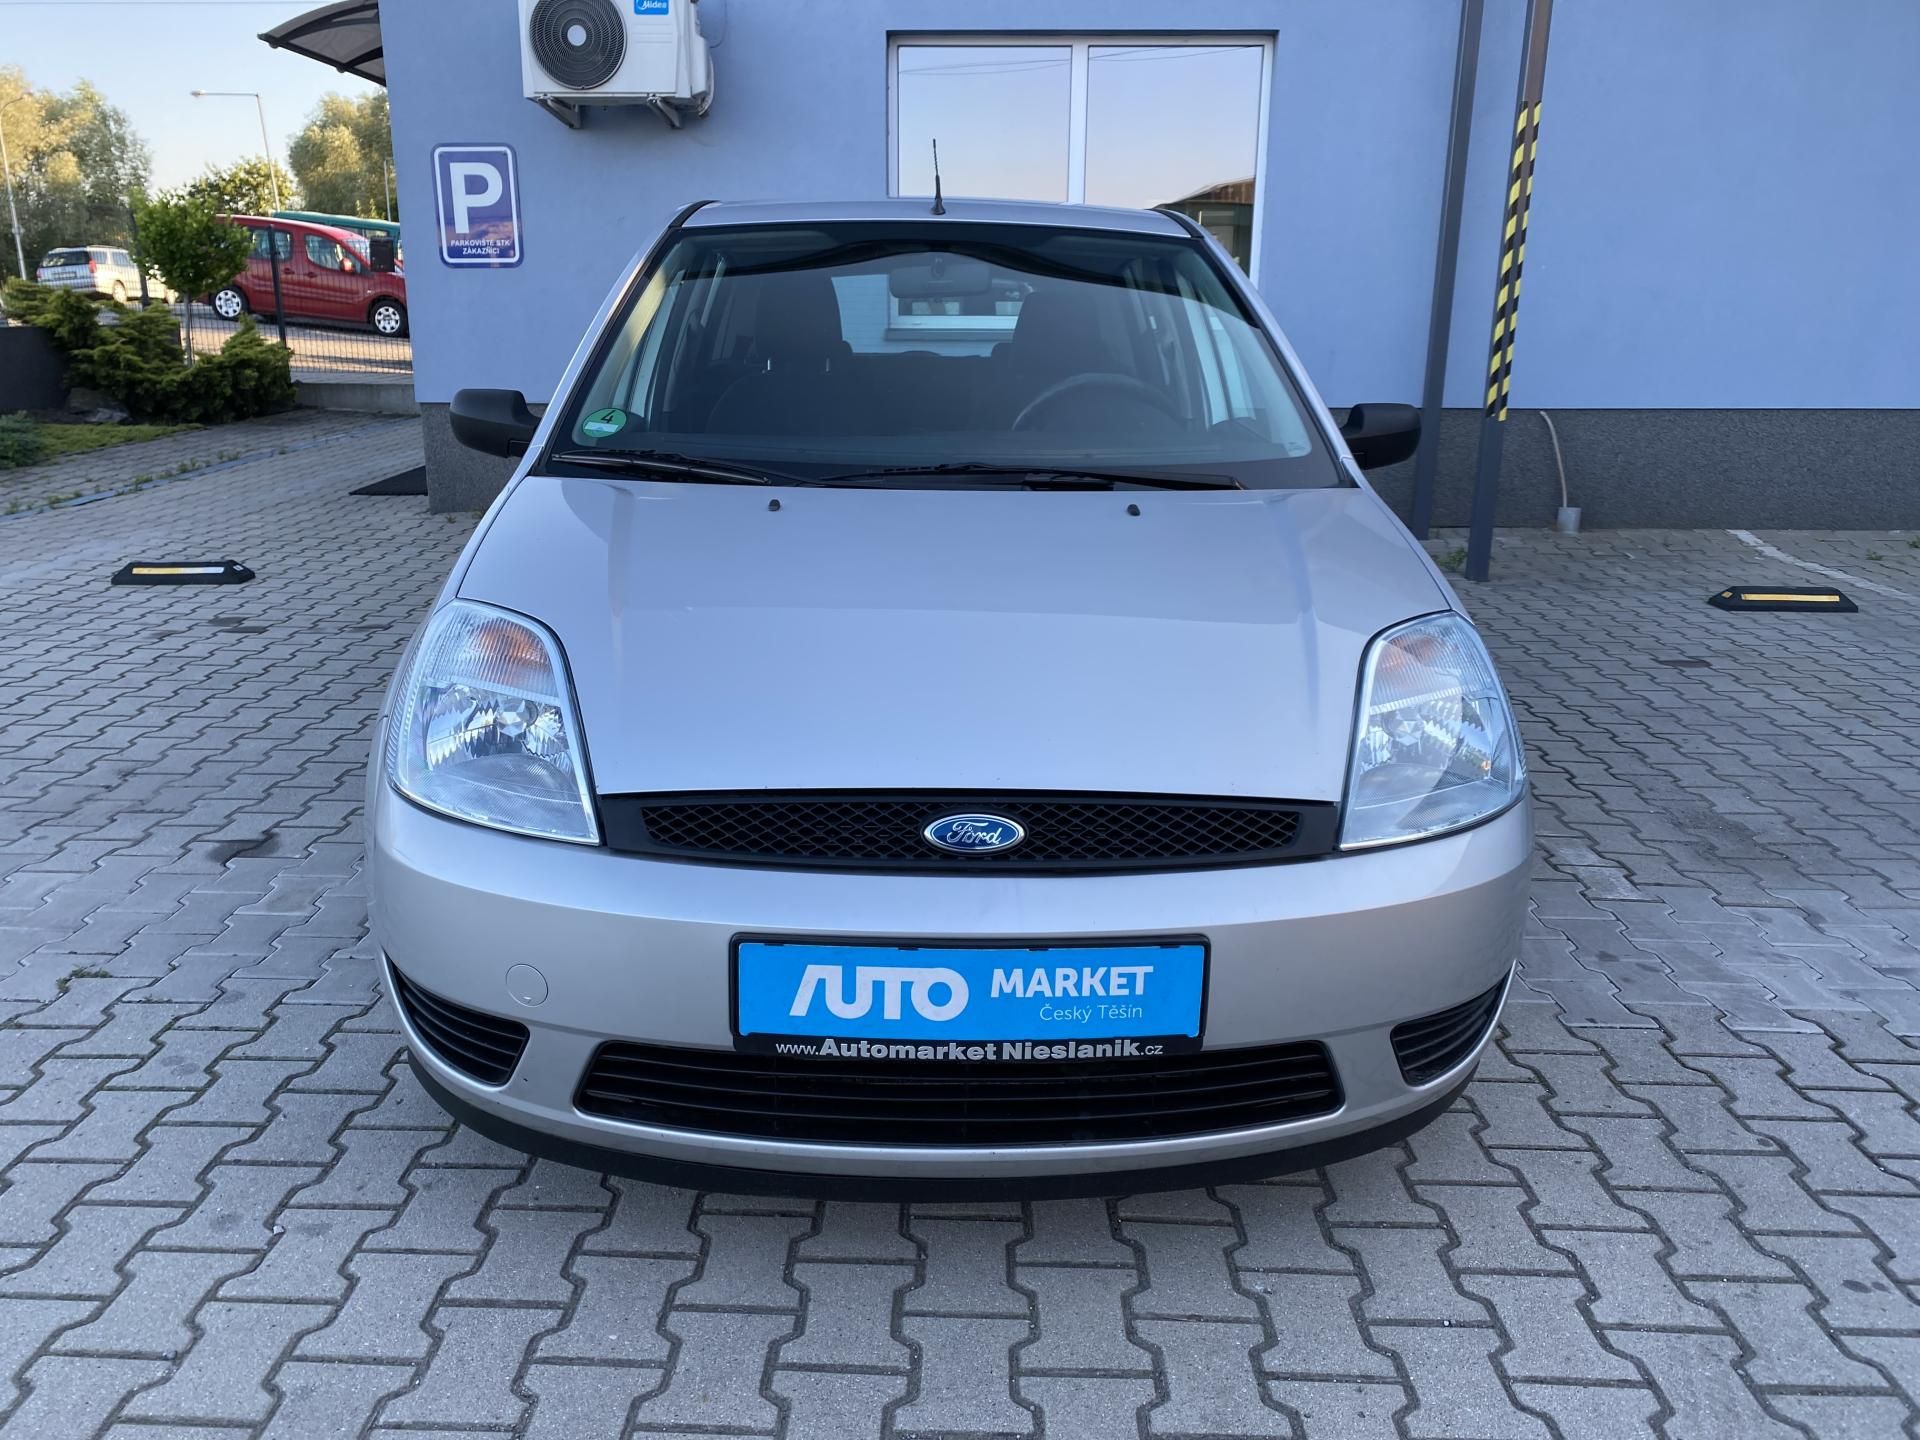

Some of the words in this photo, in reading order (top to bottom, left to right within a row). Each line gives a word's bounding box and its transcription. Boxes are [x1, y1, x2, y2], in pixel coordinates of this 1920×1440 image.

[642, 0, 667, 9] Midea
[449, 162, 503, 234] P
[601, 409, 616, 424] 4
[947, 821, 1003, 844] Ford
[789, 964, 970, 1022] AUTO
[990, 965, 1154, 999] MARKET
[1039, 1003, 1093, 1023] Český
